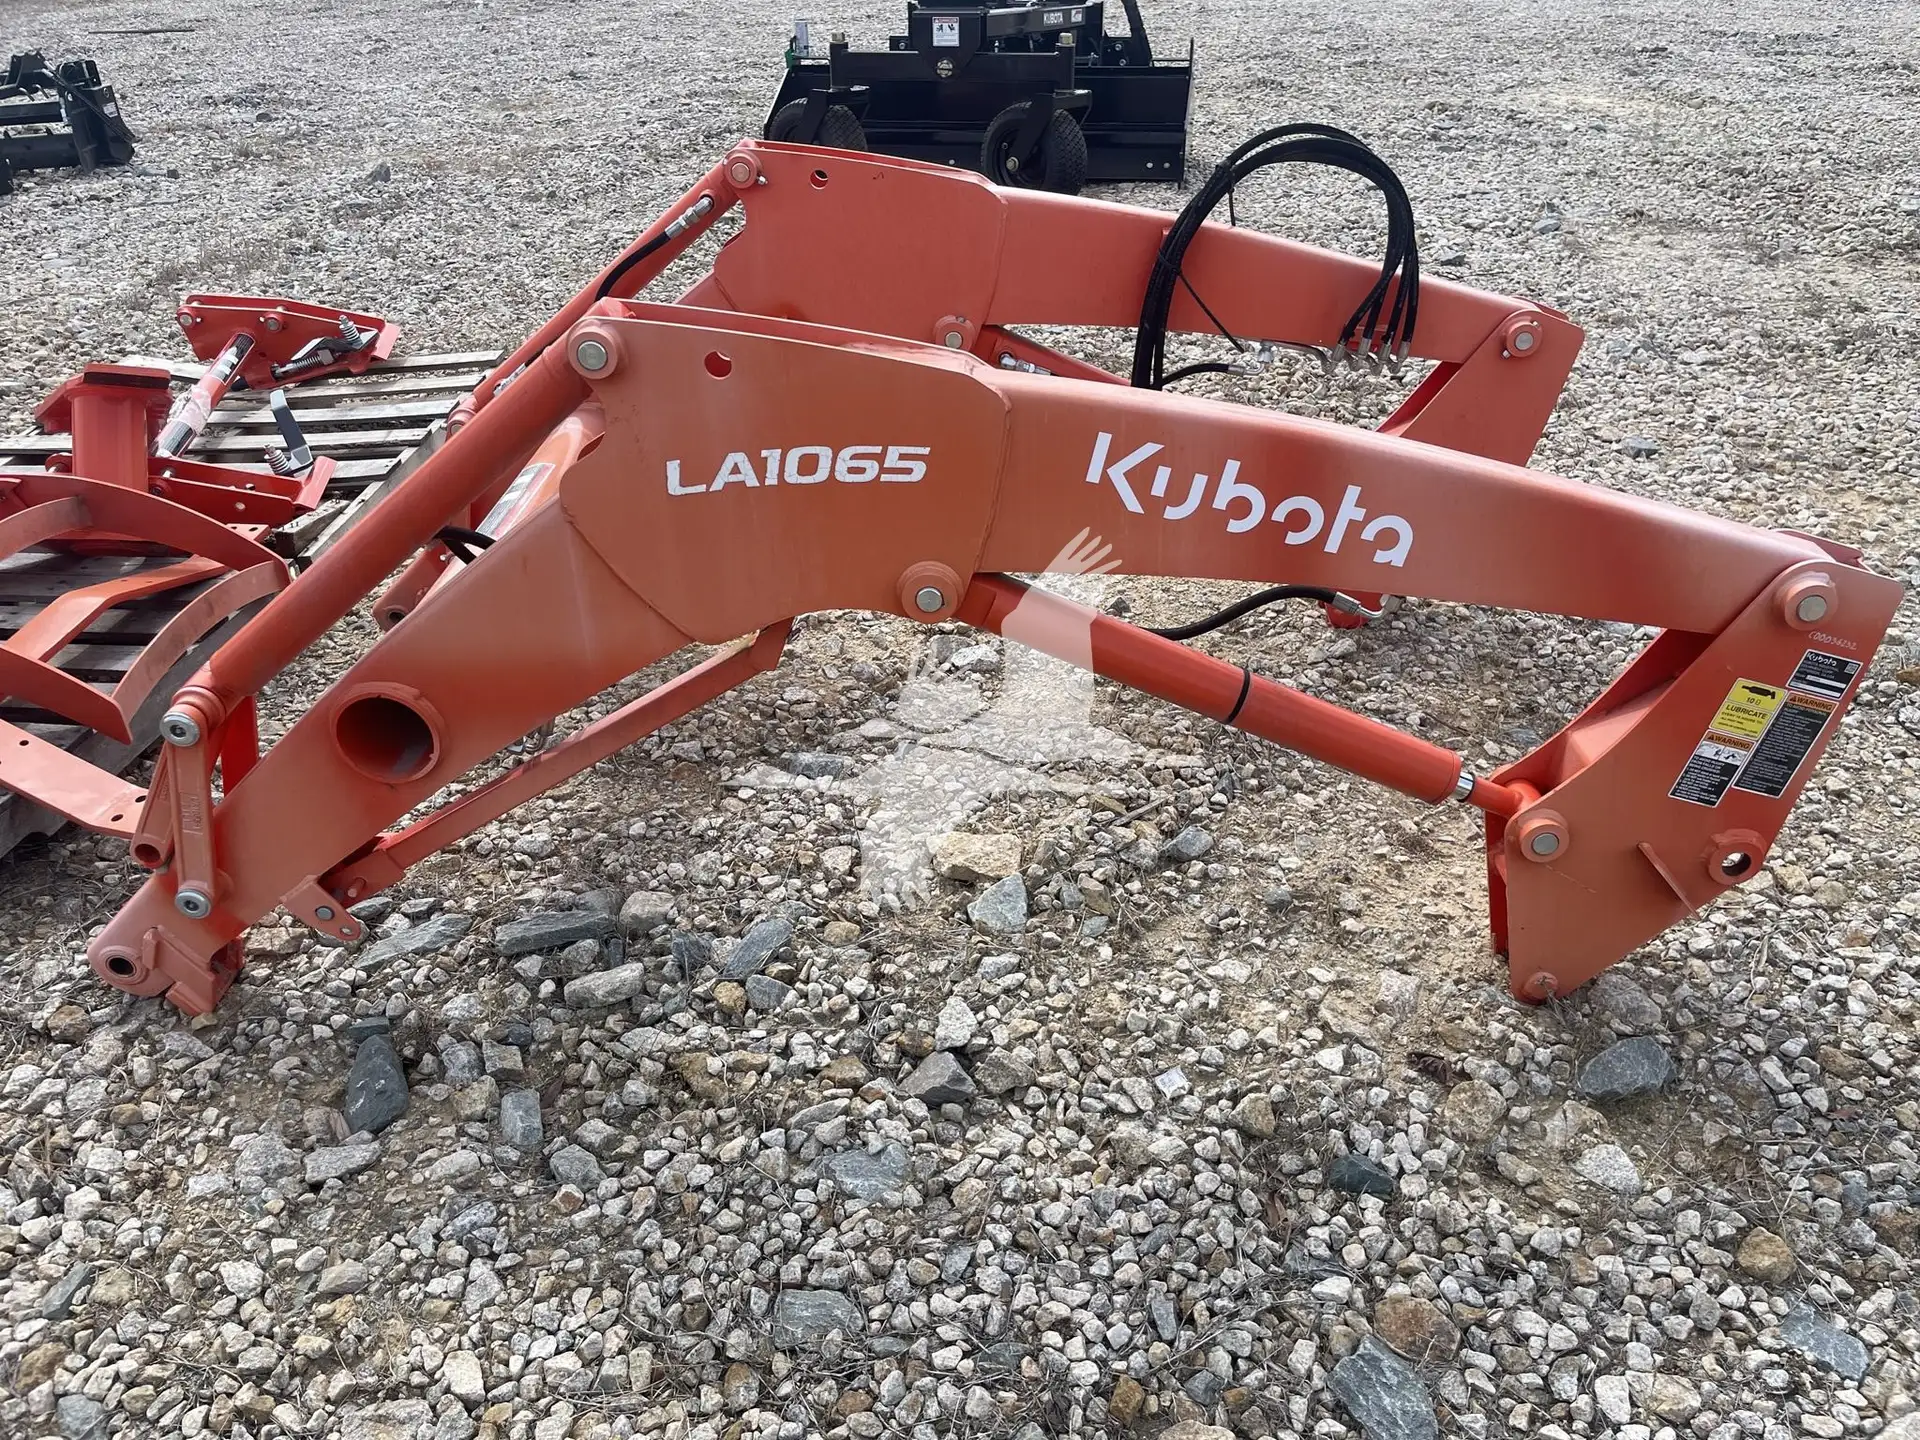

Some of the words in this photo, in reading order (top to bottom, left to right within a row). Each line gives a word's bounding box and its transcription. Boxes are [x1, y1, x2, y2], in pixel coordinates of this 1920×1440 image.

[1043, 11, 1064, 26] KUBOTA
[666, 445, 931, 496] LA1065
[1086, 432, 1414, 568] Kubota
[1806, 652, 1837, 667] Kubota
[1796, 696, 1834, 711] WARNING
[1725, 704, 1768, 720] LUBRICATE
[1714, 735, 1750, 750] WARNING
